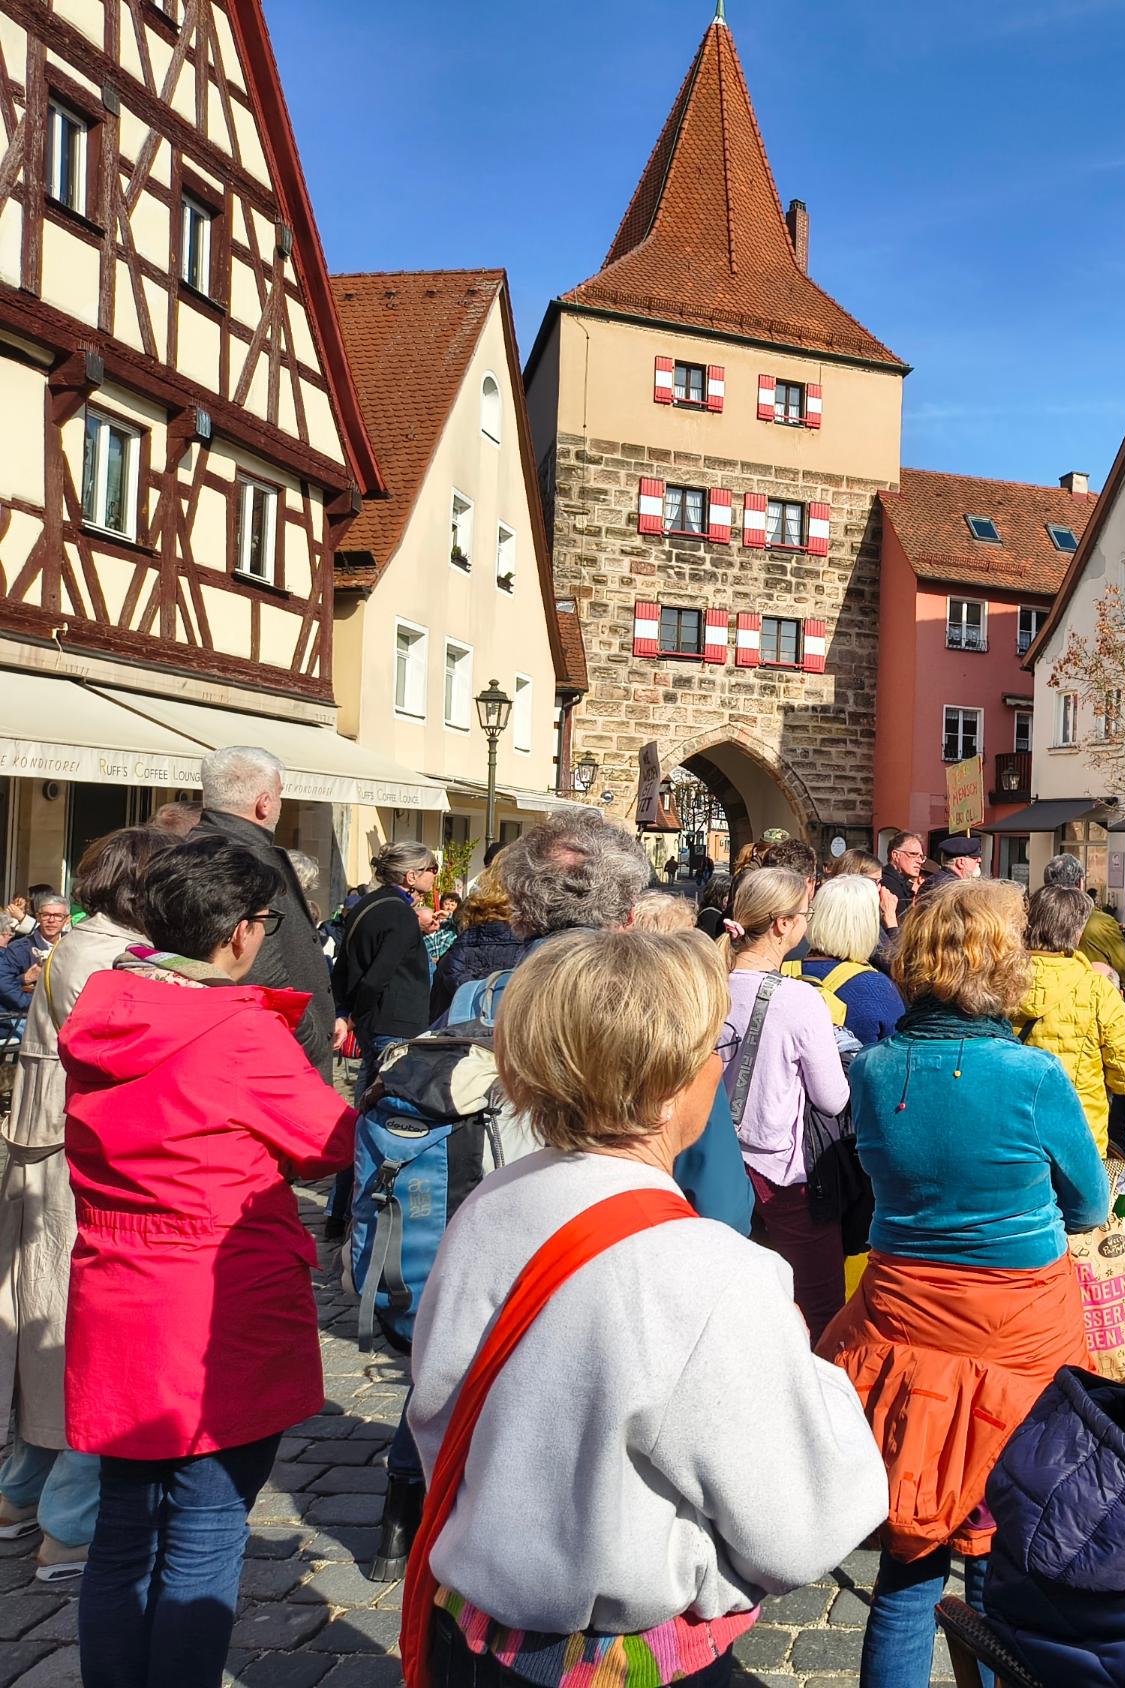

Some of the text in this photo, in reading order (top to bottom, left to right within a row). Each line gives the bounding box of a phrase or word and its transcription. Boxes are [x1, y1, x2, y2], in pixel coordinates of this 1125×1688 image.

[13, 755, 80, 772] KONDITOREI
[134, 762, 168, 780] COFFEE
[173, 764, 202, 783] LOUNG
[386, 1119, 428, 1133] deuter
[1084, 1306, 1122, 1328] SSER
[1087, 1328, 1121, 1349] BEN.
